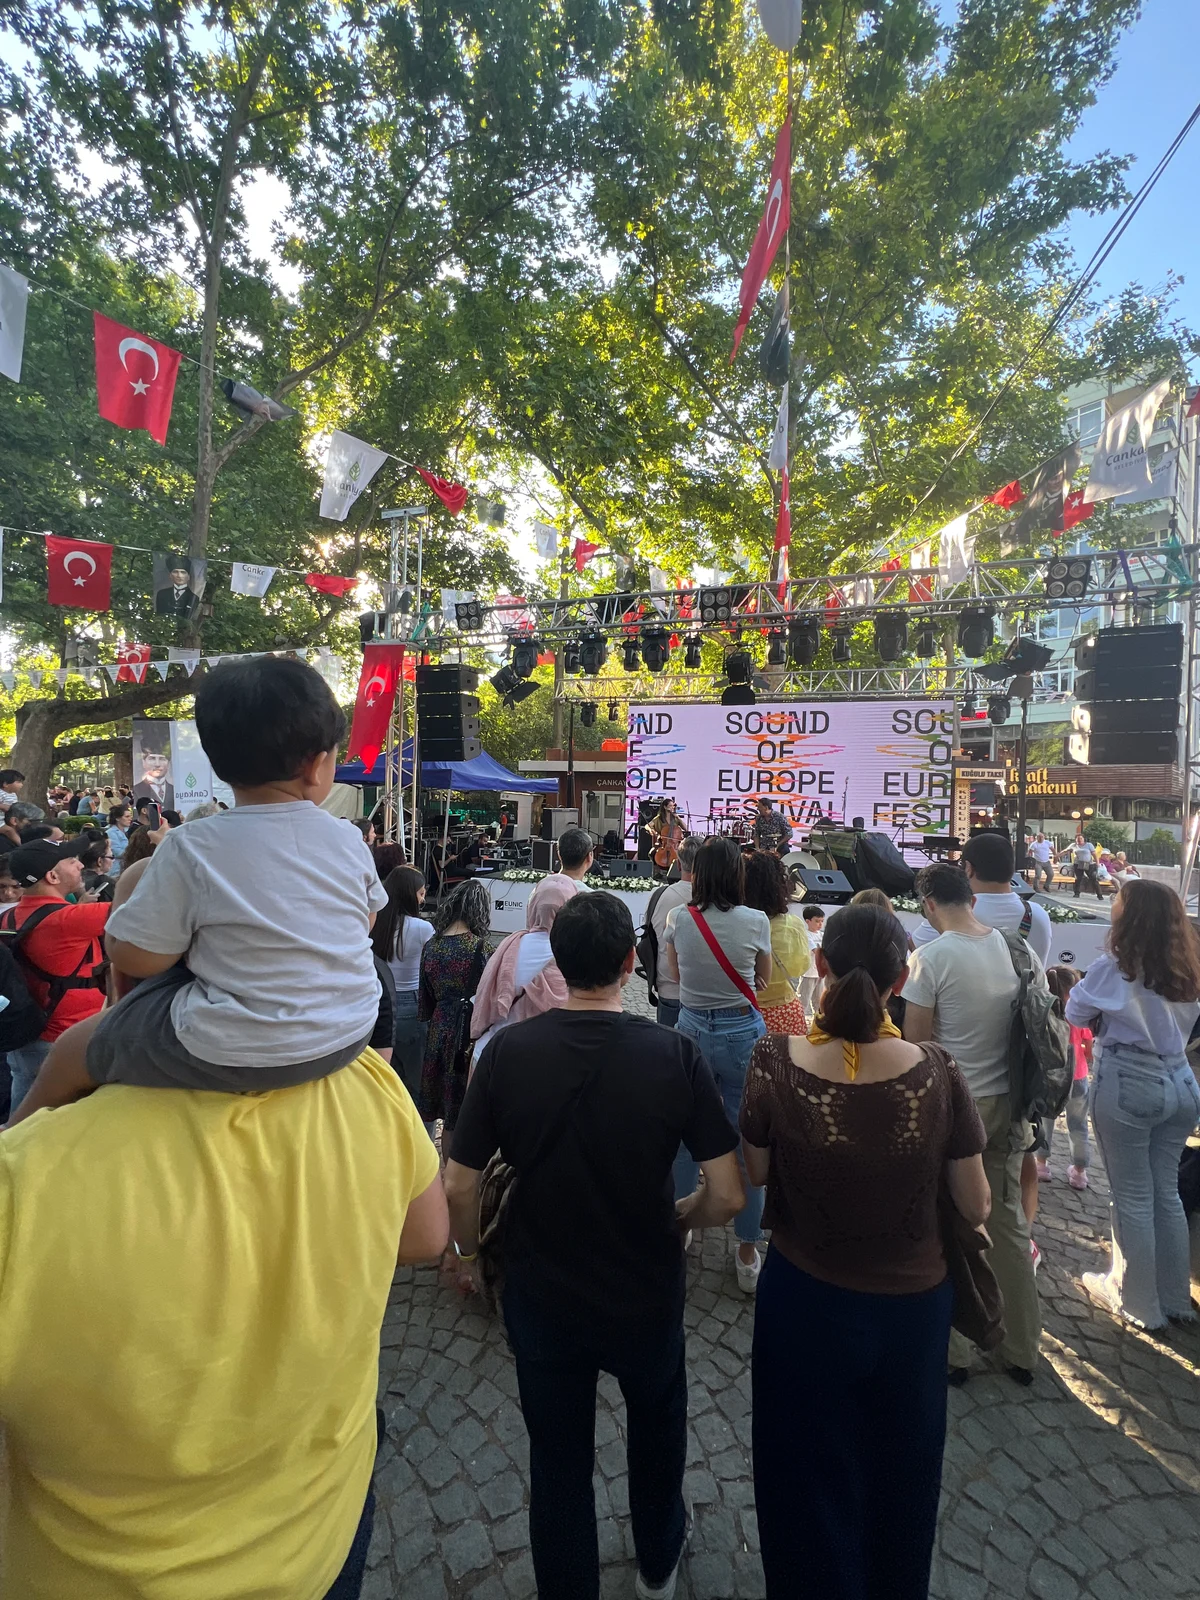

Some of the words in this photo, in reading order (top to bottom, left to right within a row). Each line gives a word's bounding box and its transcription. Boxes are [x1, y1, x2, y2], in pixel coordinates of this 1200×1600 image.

[725, 710, 830, 735] SOUND
[757, 740, 795, 764] OF
[718, 769, 835, 794] EUROPE
[1009, 767, 1048, 782] kaft
[709, 797, 844, 824] FESIVAL
